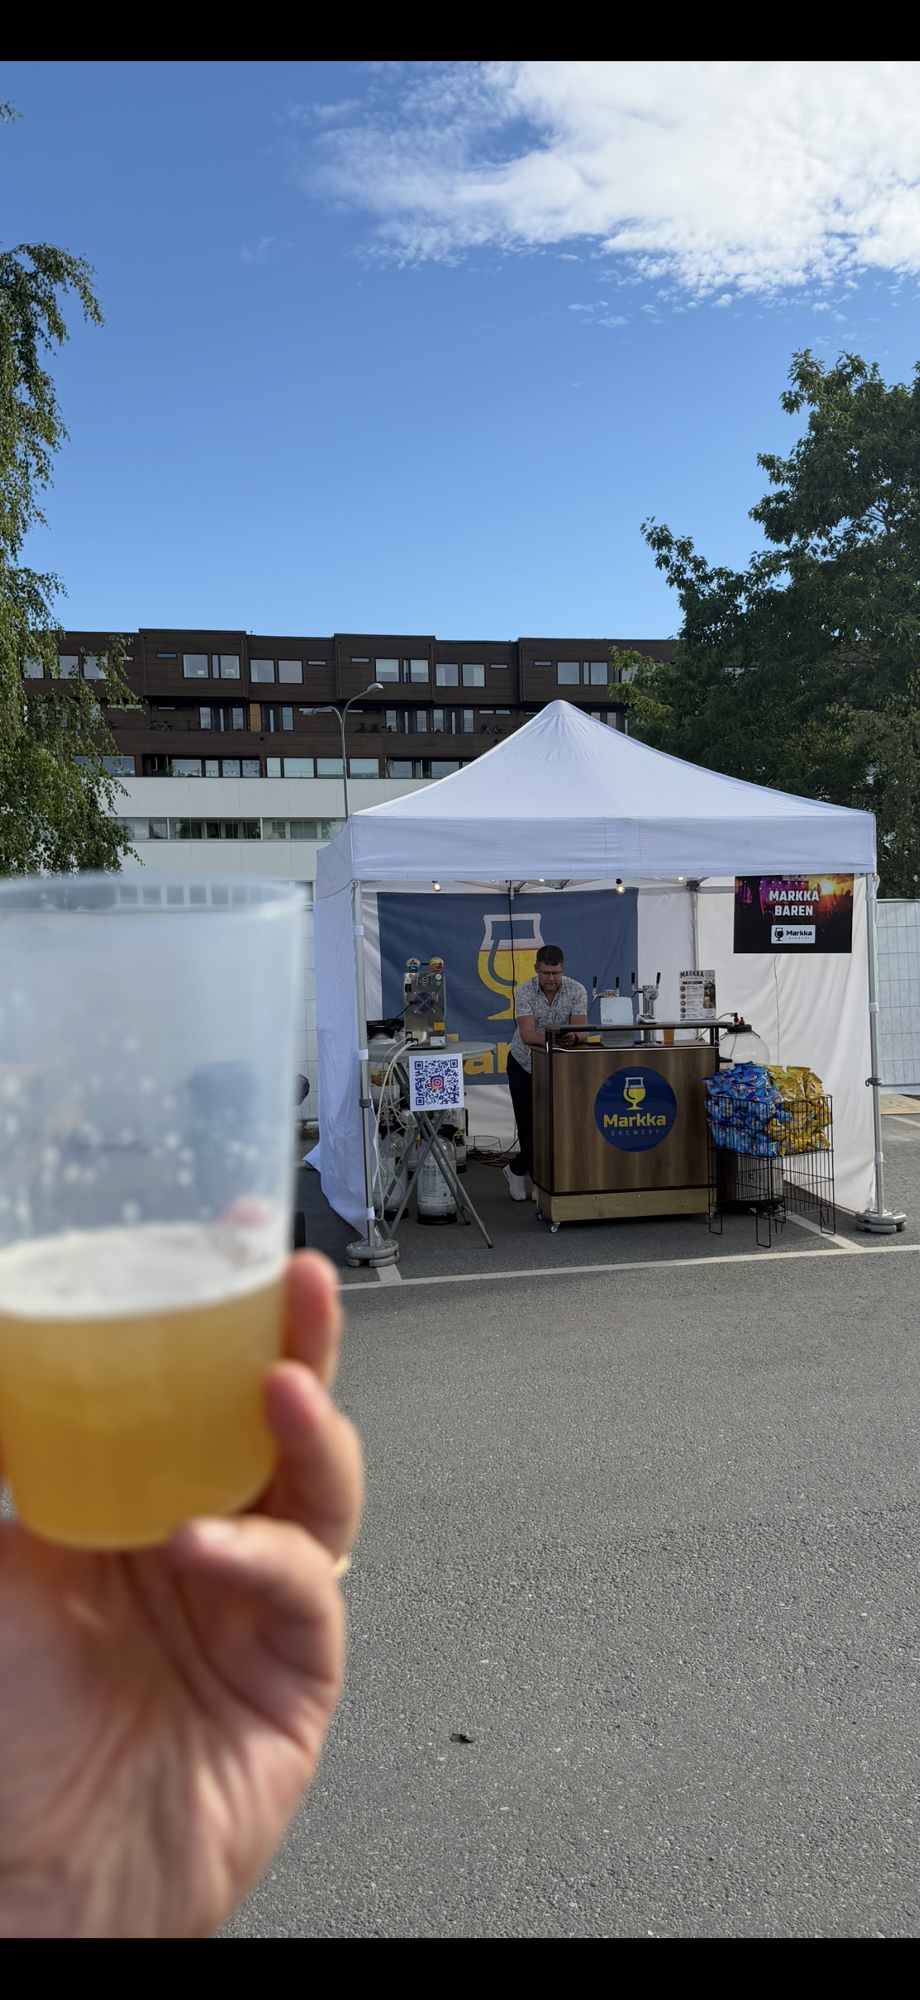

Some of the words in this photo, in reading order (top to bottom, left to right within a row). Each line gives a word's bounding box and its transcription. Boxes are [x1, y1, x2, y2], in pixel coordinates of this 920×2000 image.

[769, 890, 820, 902] MARKKA
[774, 905, 813, 916] BAREN
[680, 970, 704, 979] MARKKA
[603, 1113, 666, 1128] Markka
[610, 1129, 660, 1137] BREWERY
